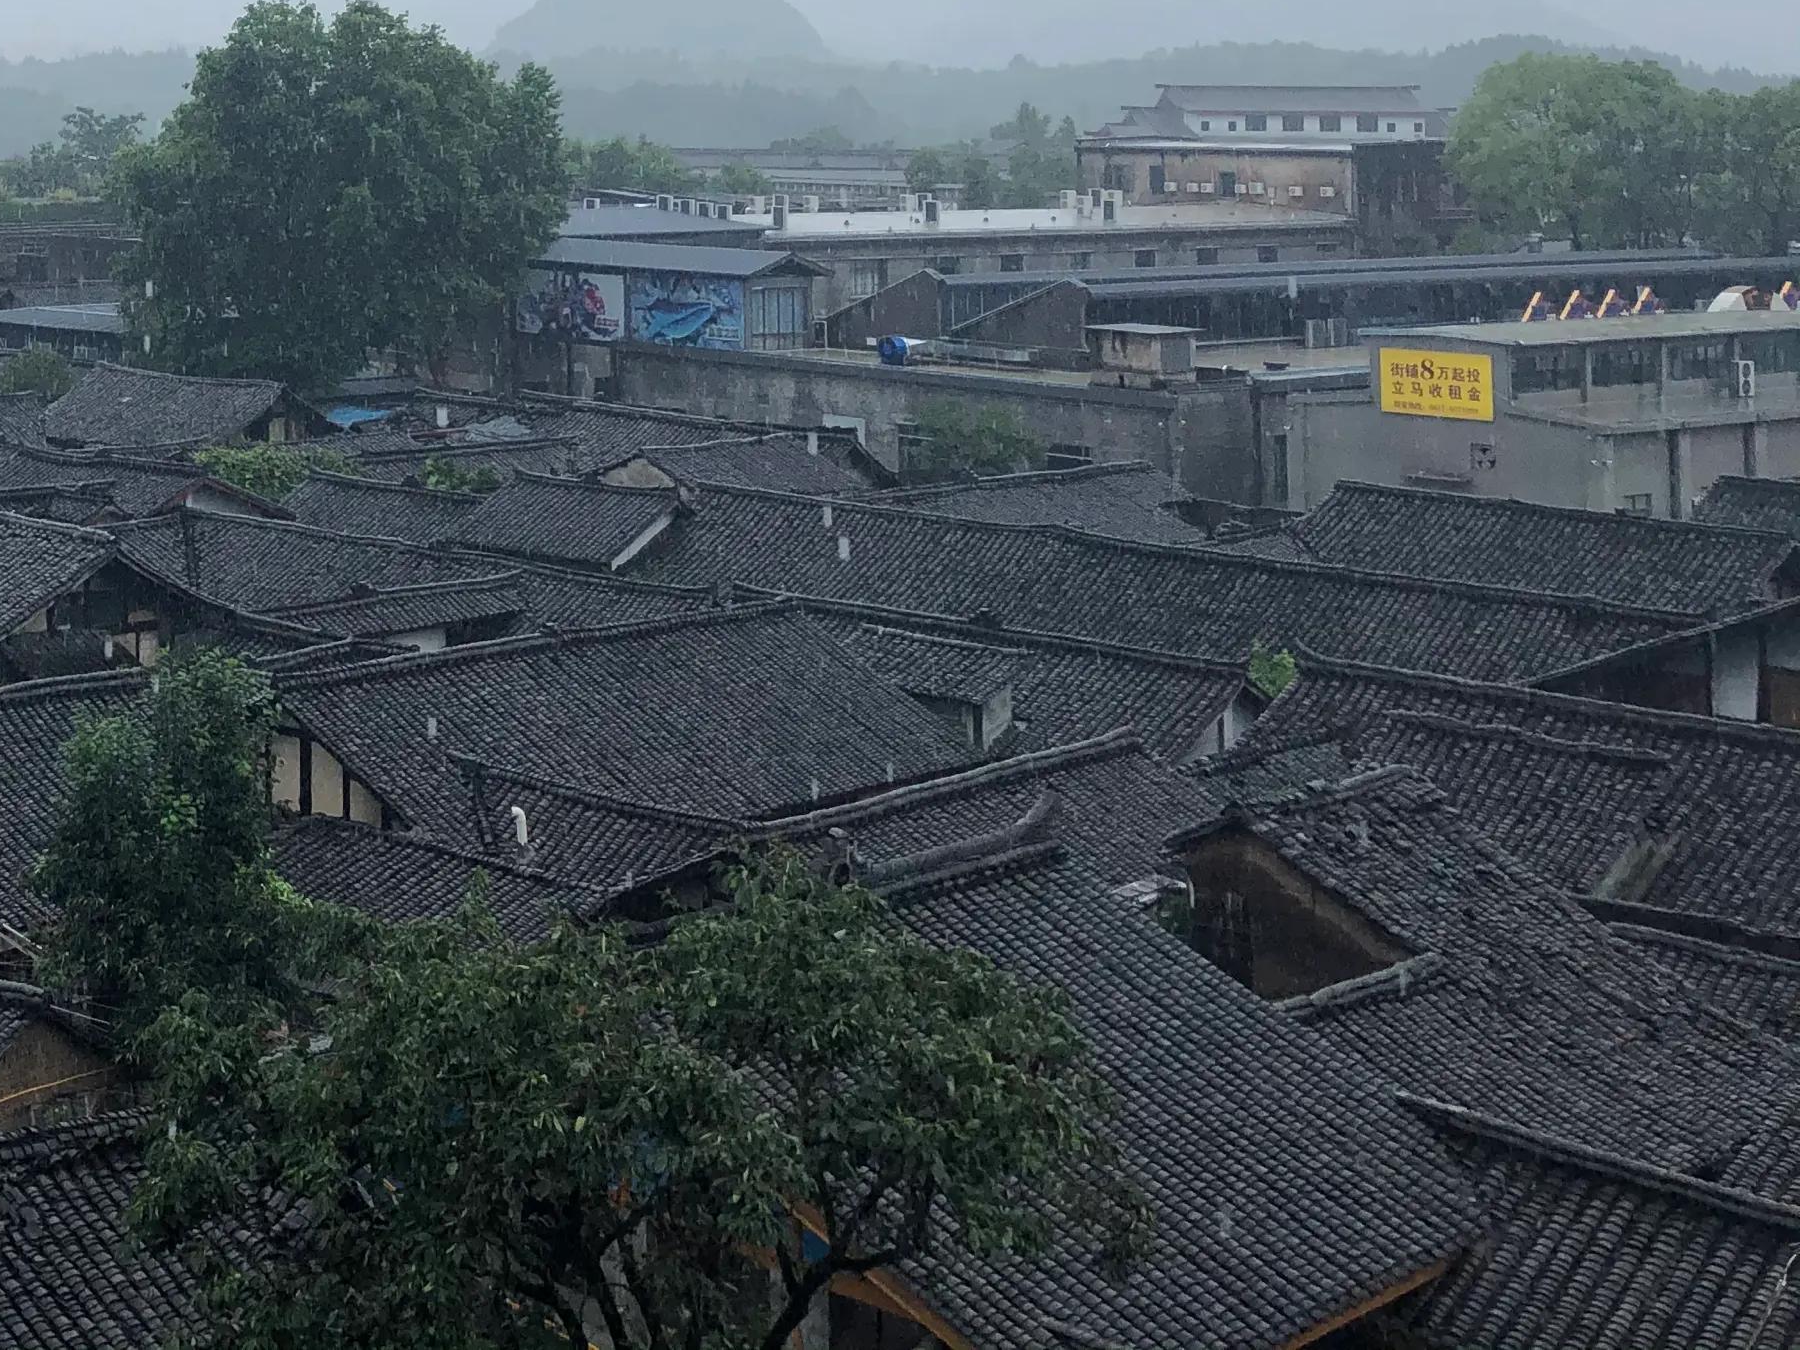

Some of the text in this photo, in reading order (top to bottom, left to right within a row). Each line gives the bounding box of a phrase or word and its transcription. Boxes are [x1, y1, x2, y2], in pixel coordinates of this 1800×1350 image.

[1390, 358, 1481, 384] 街铺8万起投
[1391, 380, 1481, 402] 立马收租金
